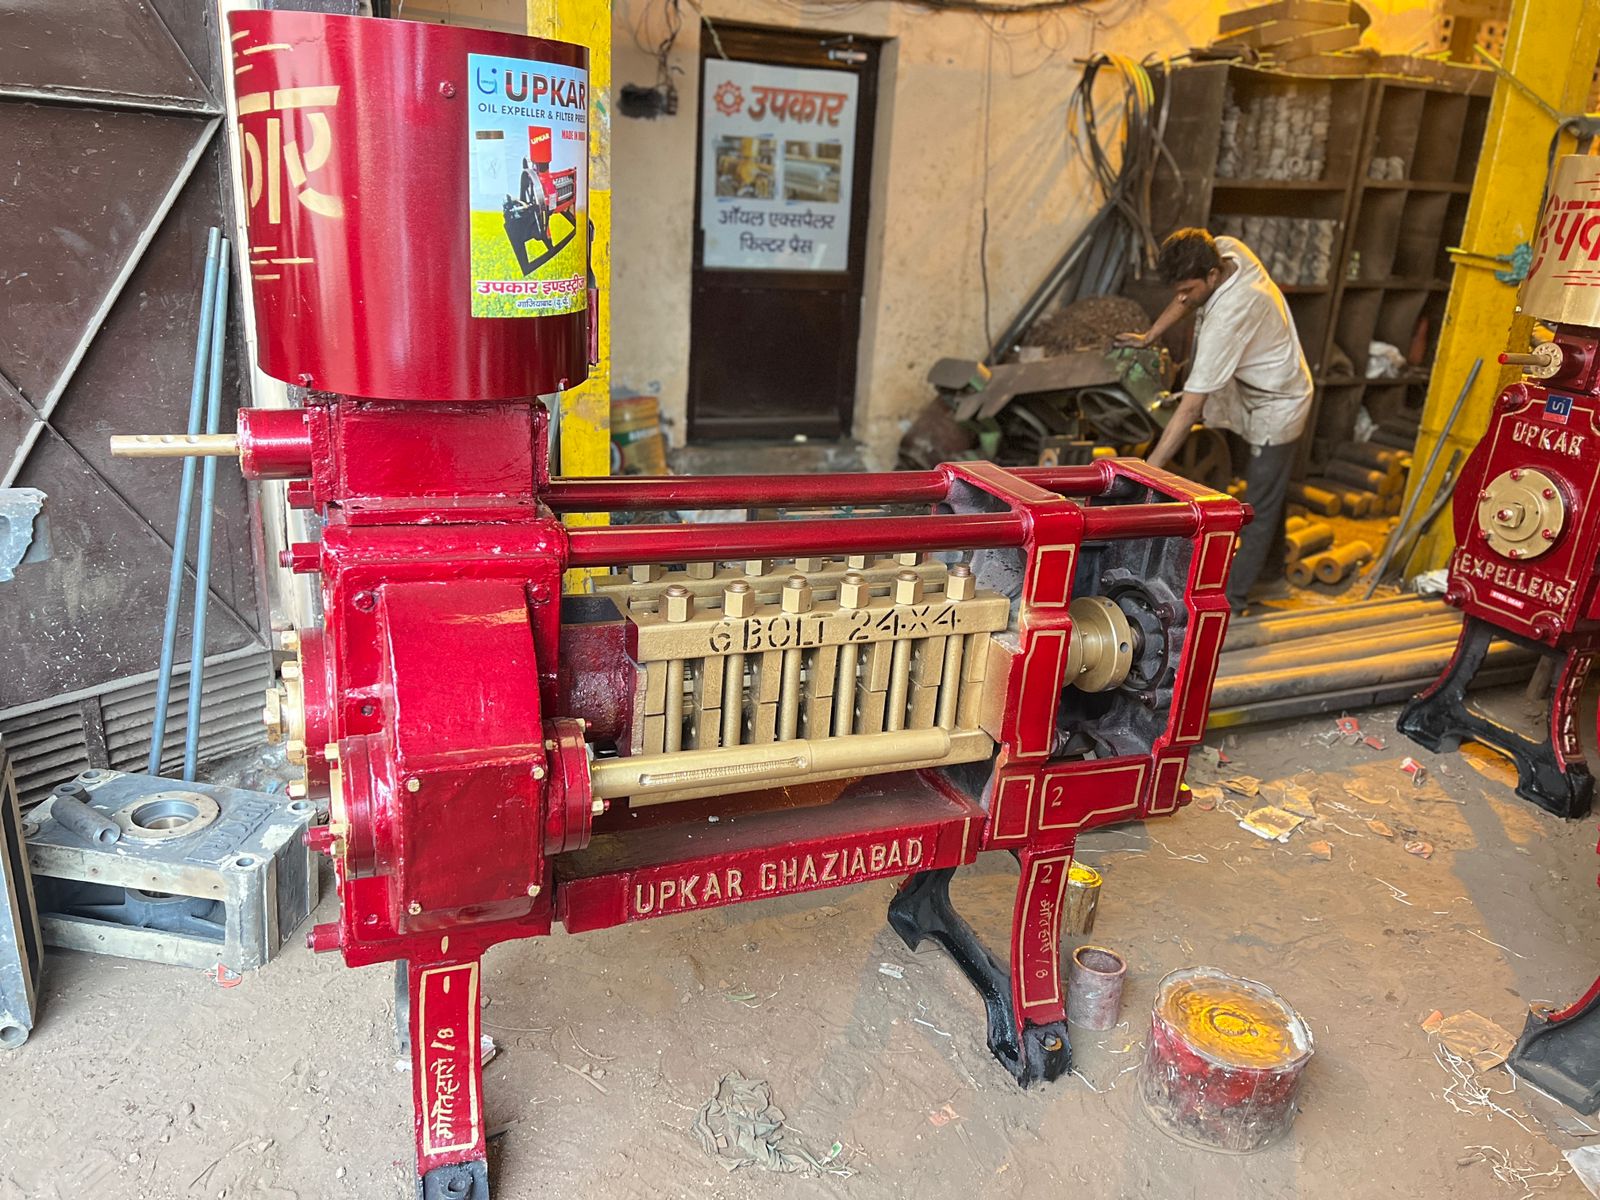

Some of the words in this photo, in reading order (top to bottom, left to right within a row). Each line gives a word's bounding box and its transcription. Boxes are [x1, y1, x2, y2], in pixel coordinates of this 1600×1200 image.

[505, 69, 586, 111] UPKAR
[747, 84, 849, 127] उपकार
[478, 102, 498, 114] OIL
[501, 105, 546, 119] EXPELLER
[547, 110, 554, 120] &
[555, 111, 575, 122] FILTER
[477, 281, 539, 294] उपकार
[1512, 420, 1586, 456] UPKAR
[1459, 552, 1569, 605] EXPELLERS
[708, 621, 732, 653] 6
[743, 612, 834, 651] BOLT
[1051, 786, 1064, 807] 2
[635, 868, 744, 914] UPKAR
[761, 837, 924, 892] GHAZIABAD
[1040, 864, 1054, 885] 2
